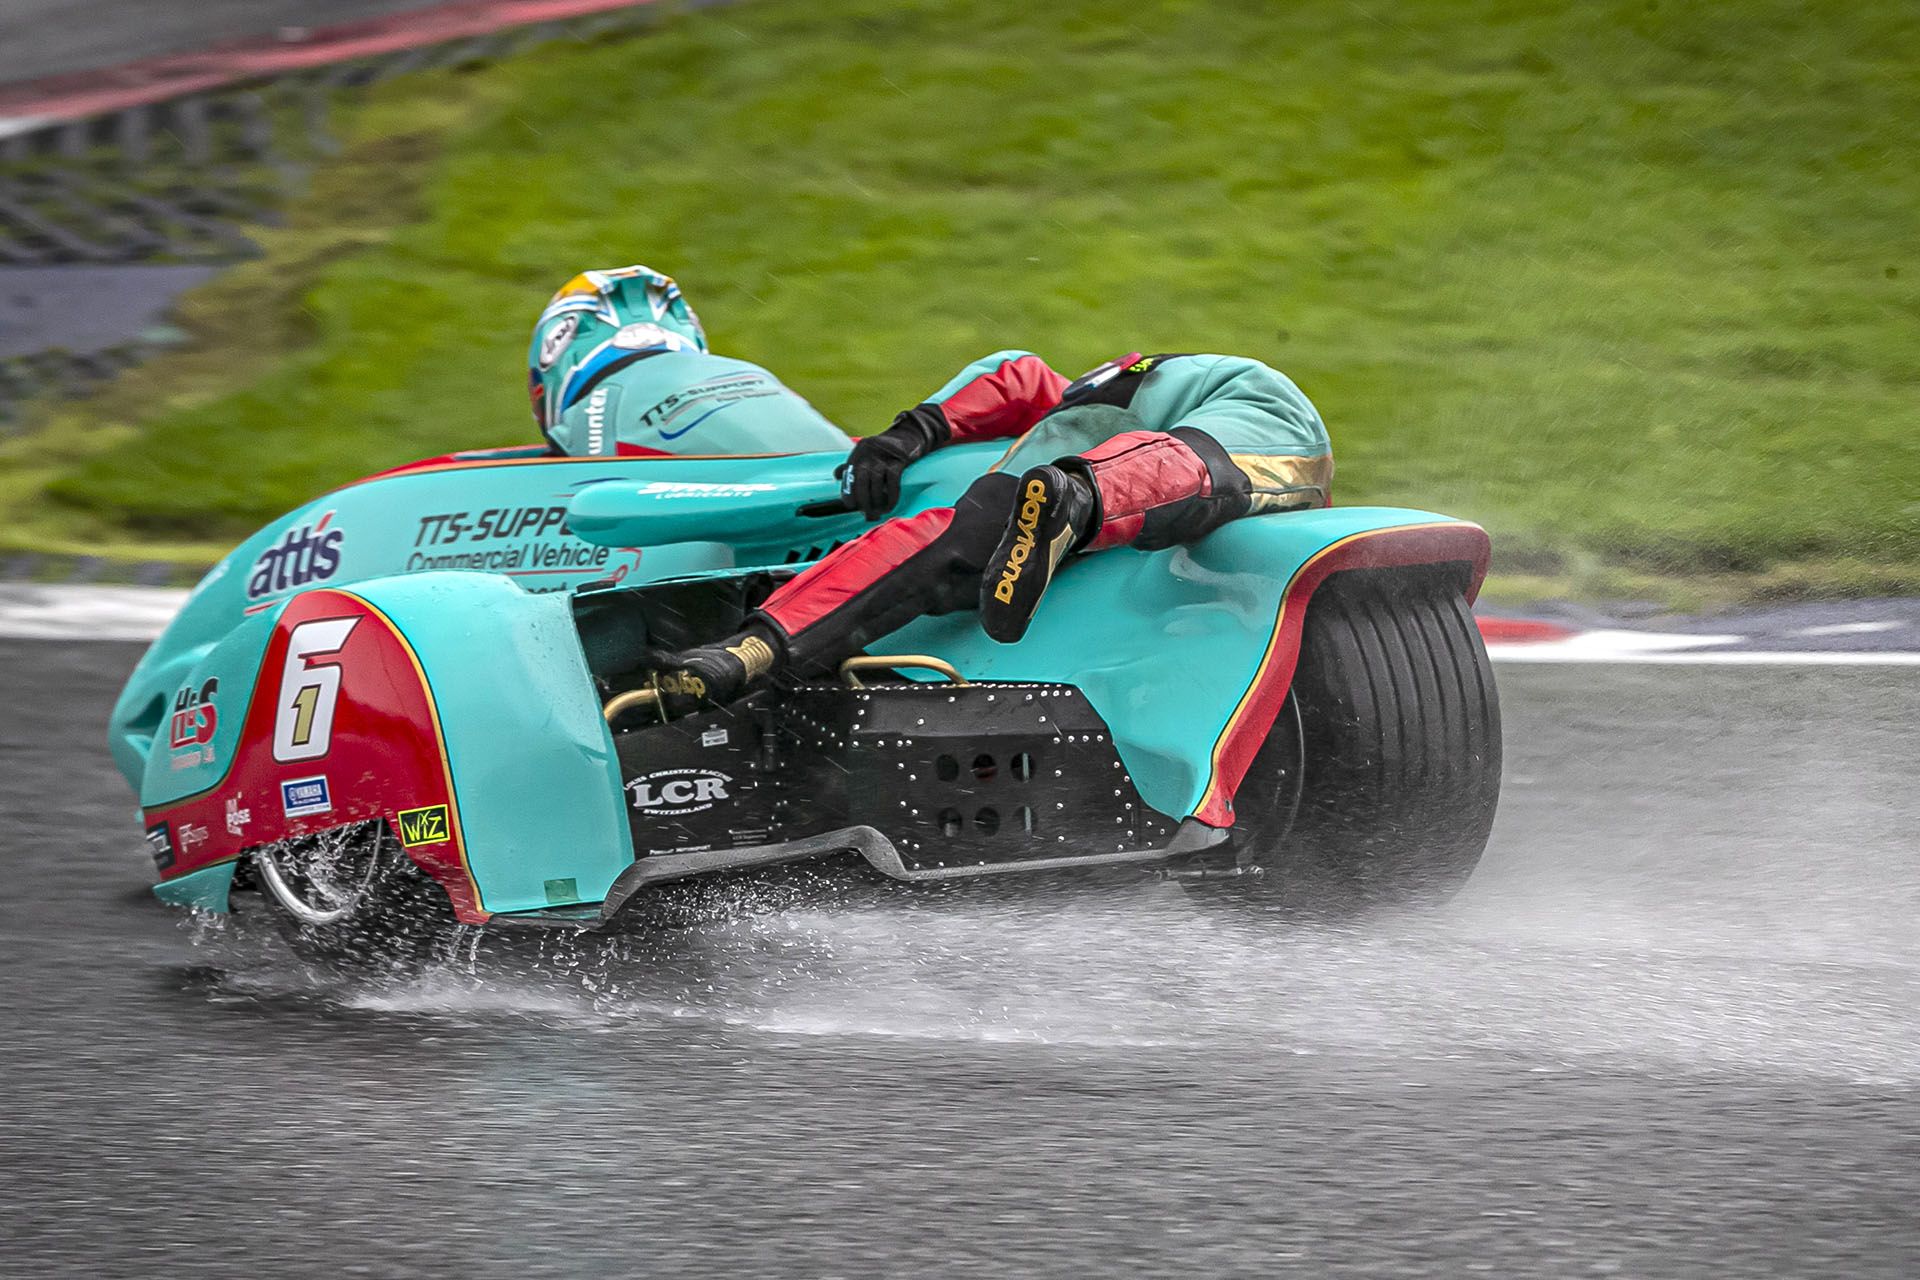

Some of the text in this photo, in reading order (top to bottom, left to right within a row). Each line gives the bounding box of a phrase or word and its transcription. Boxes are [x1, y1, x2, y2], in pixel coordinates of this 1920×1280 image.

[414, 507, 574, 547] TTS-SUPP
[994, 479, 1047, 604] daytona
[247, 509, 344, 598] attis
[406, 541, 609, 571] Commercial Vehicle
[272, 615, 363, 763] 6
[649, 769, 697, 779] CHRISTEN
[632, 778, 729, 807] LCR
[643, 803, 713, 815] SWITZERLAND
